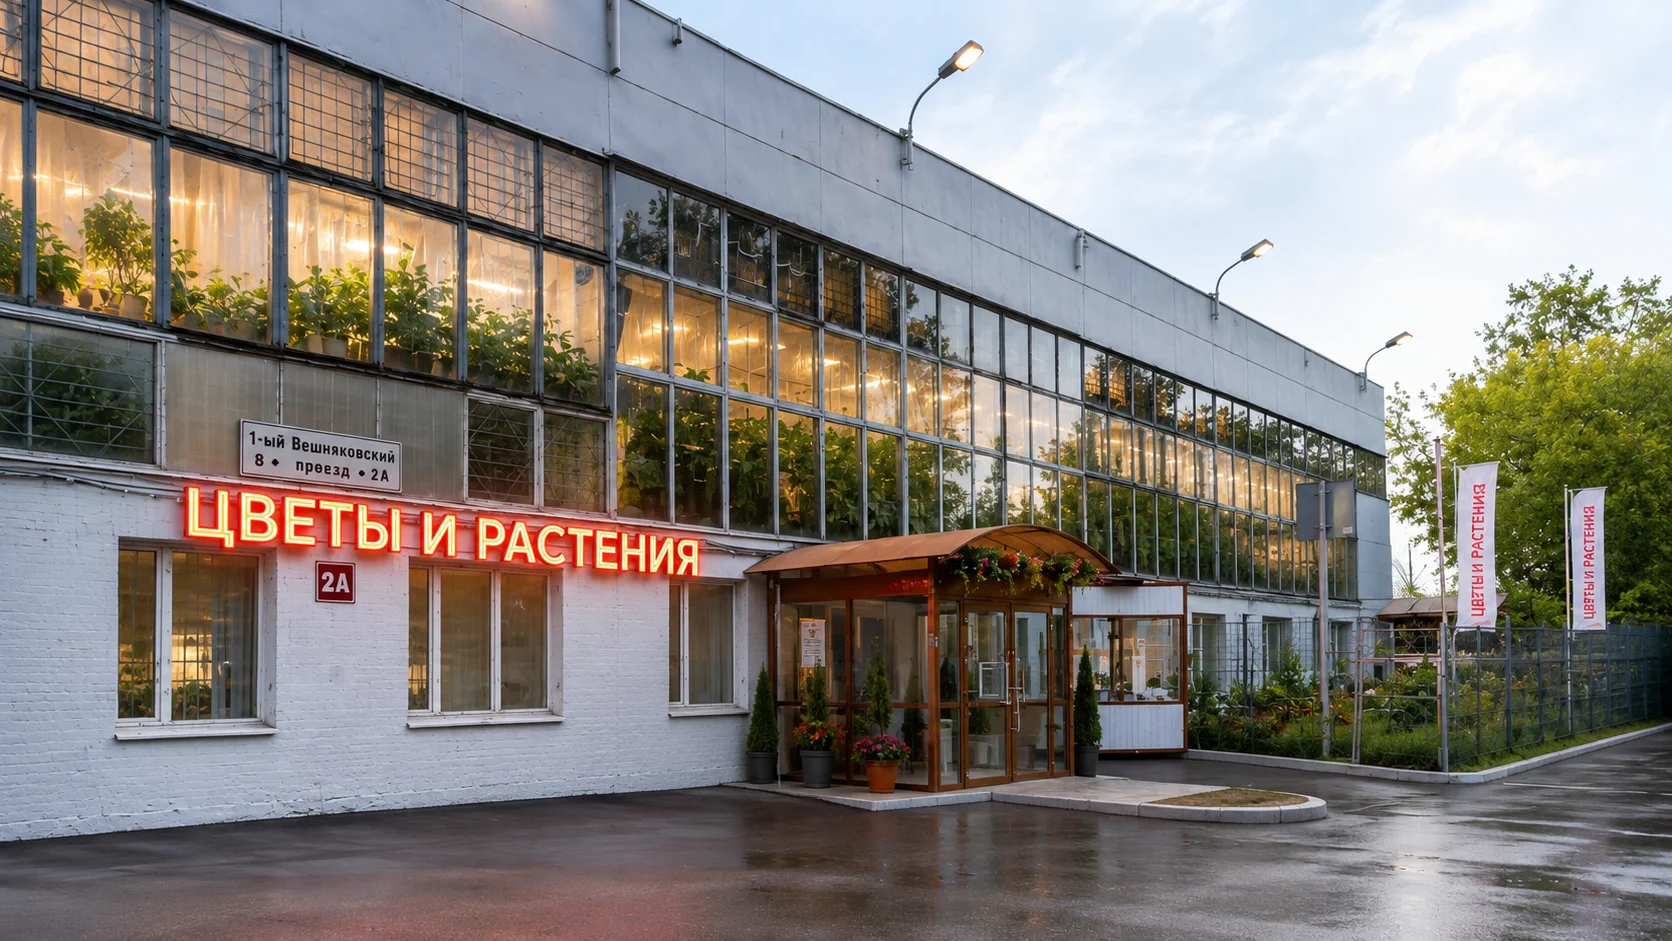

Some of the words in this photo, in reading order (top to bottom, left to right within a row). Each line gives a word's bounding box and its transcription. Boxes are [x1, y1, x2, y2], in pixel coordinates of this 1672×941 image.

[249, 431, 285, 449] 1-ый
[291, 436, 395, 464] Вешняковский
[254, 453, 265, 467] 8
[184, 486, 402, 552] ЦВЕТЫ
[419, 511, 457, 557] И
[475, 516, 699, 576] РАСТЕНИЯ
[1471, 483, 1486, 559] РАСТЕНИЯ
[1583, 505, 1595, 568] РАСТЕНИЯ
[321, 571, 350, 593] 2А
[1471, 563, 1484, 573] И
